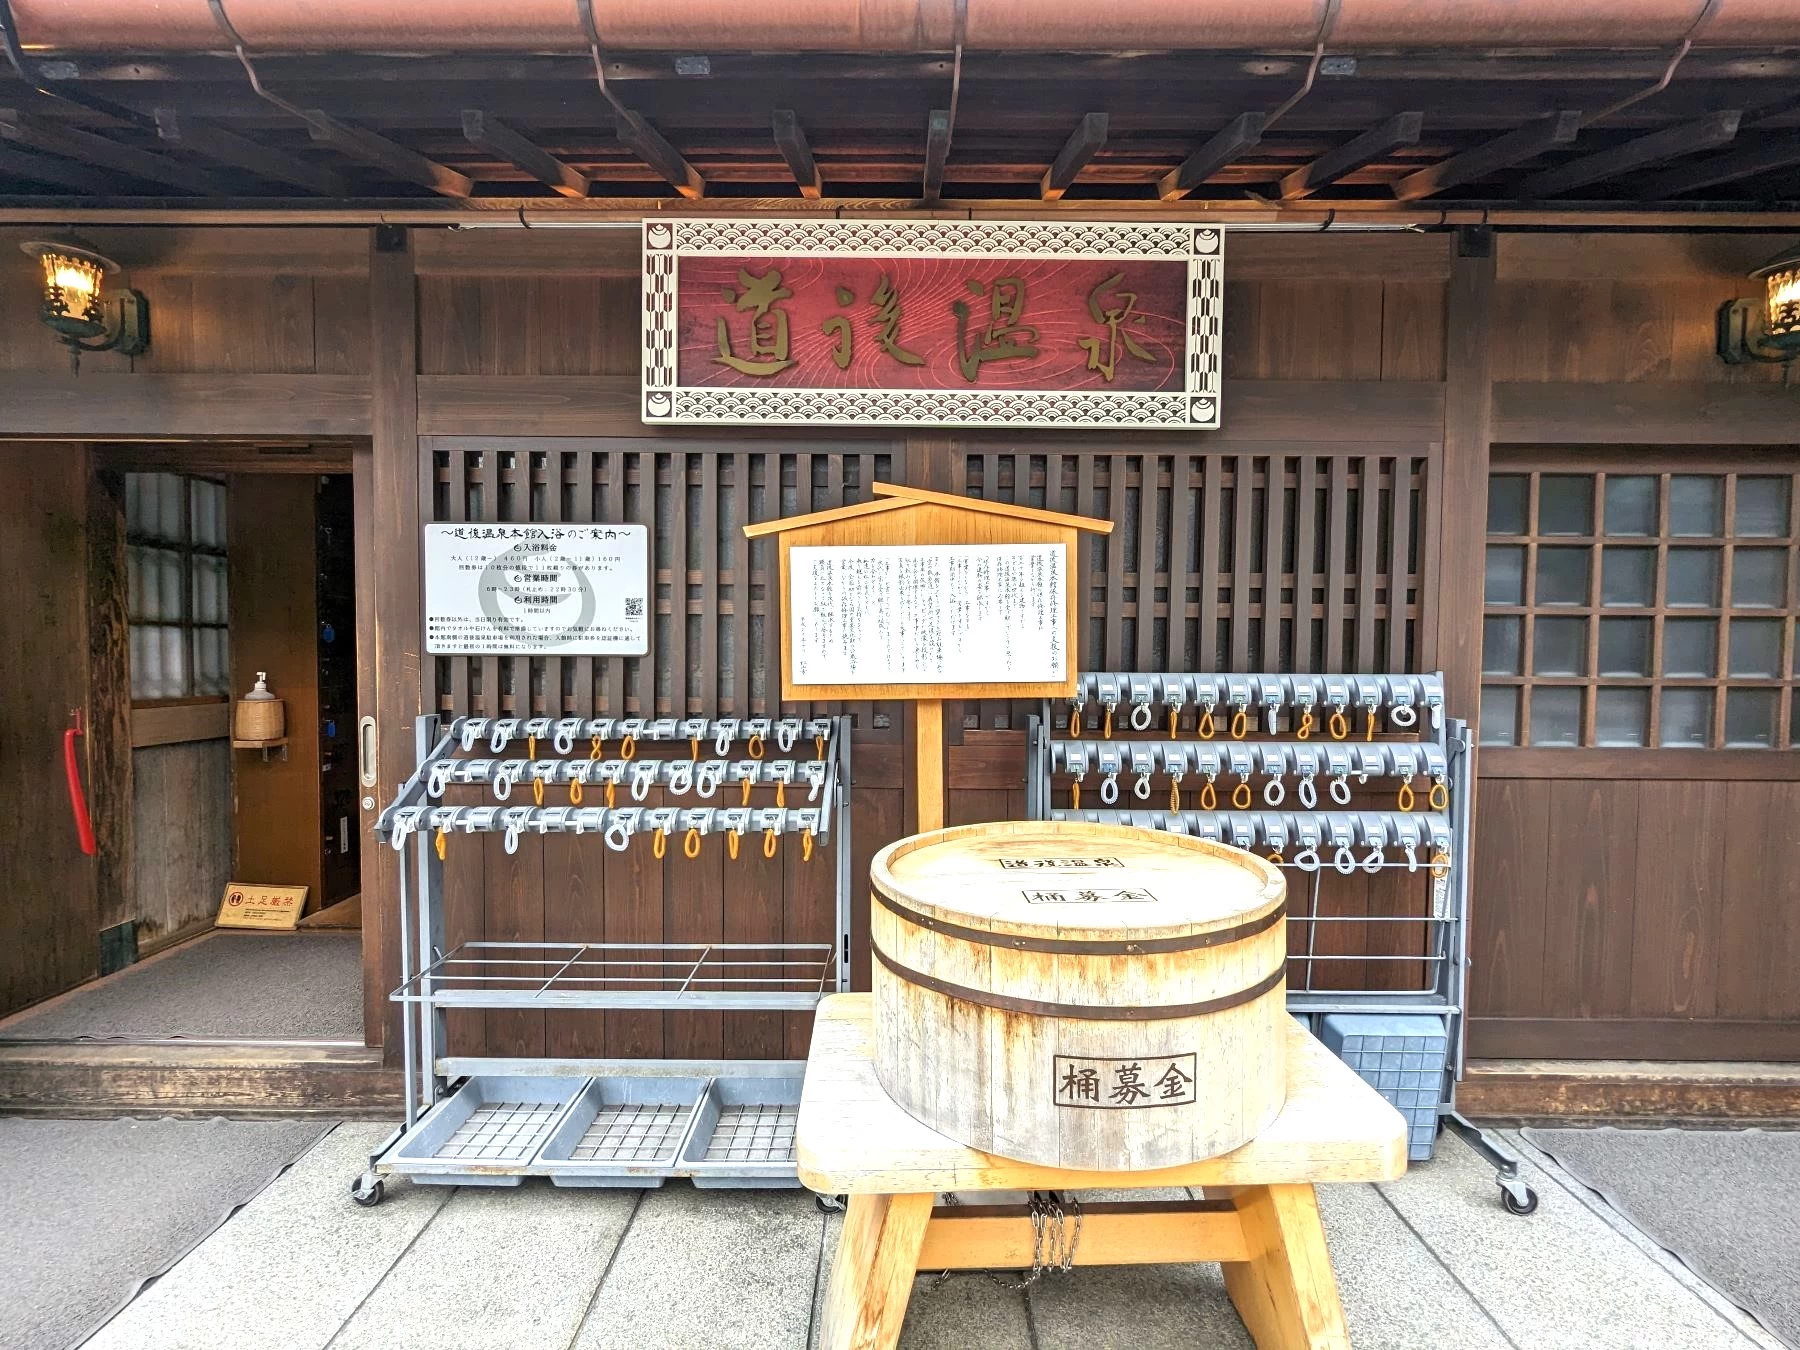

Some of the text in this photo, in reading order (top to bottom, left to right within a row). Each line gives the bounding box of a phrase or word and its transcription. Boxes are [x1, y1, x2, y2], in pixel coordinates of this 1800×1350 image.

[711, 266, 1158, 384] 道後温泉
[523, 543, 557, 552] 入浴料金
[523, 574, 558, 582] 営業時間
[523, 595, 558, 604] 利用時間
[245, 895, 294, 907] 土足厳禁
[1031, 890, 1148, 902] 桶募金
[1059, 1062, 1192, 1105] 桶募金
